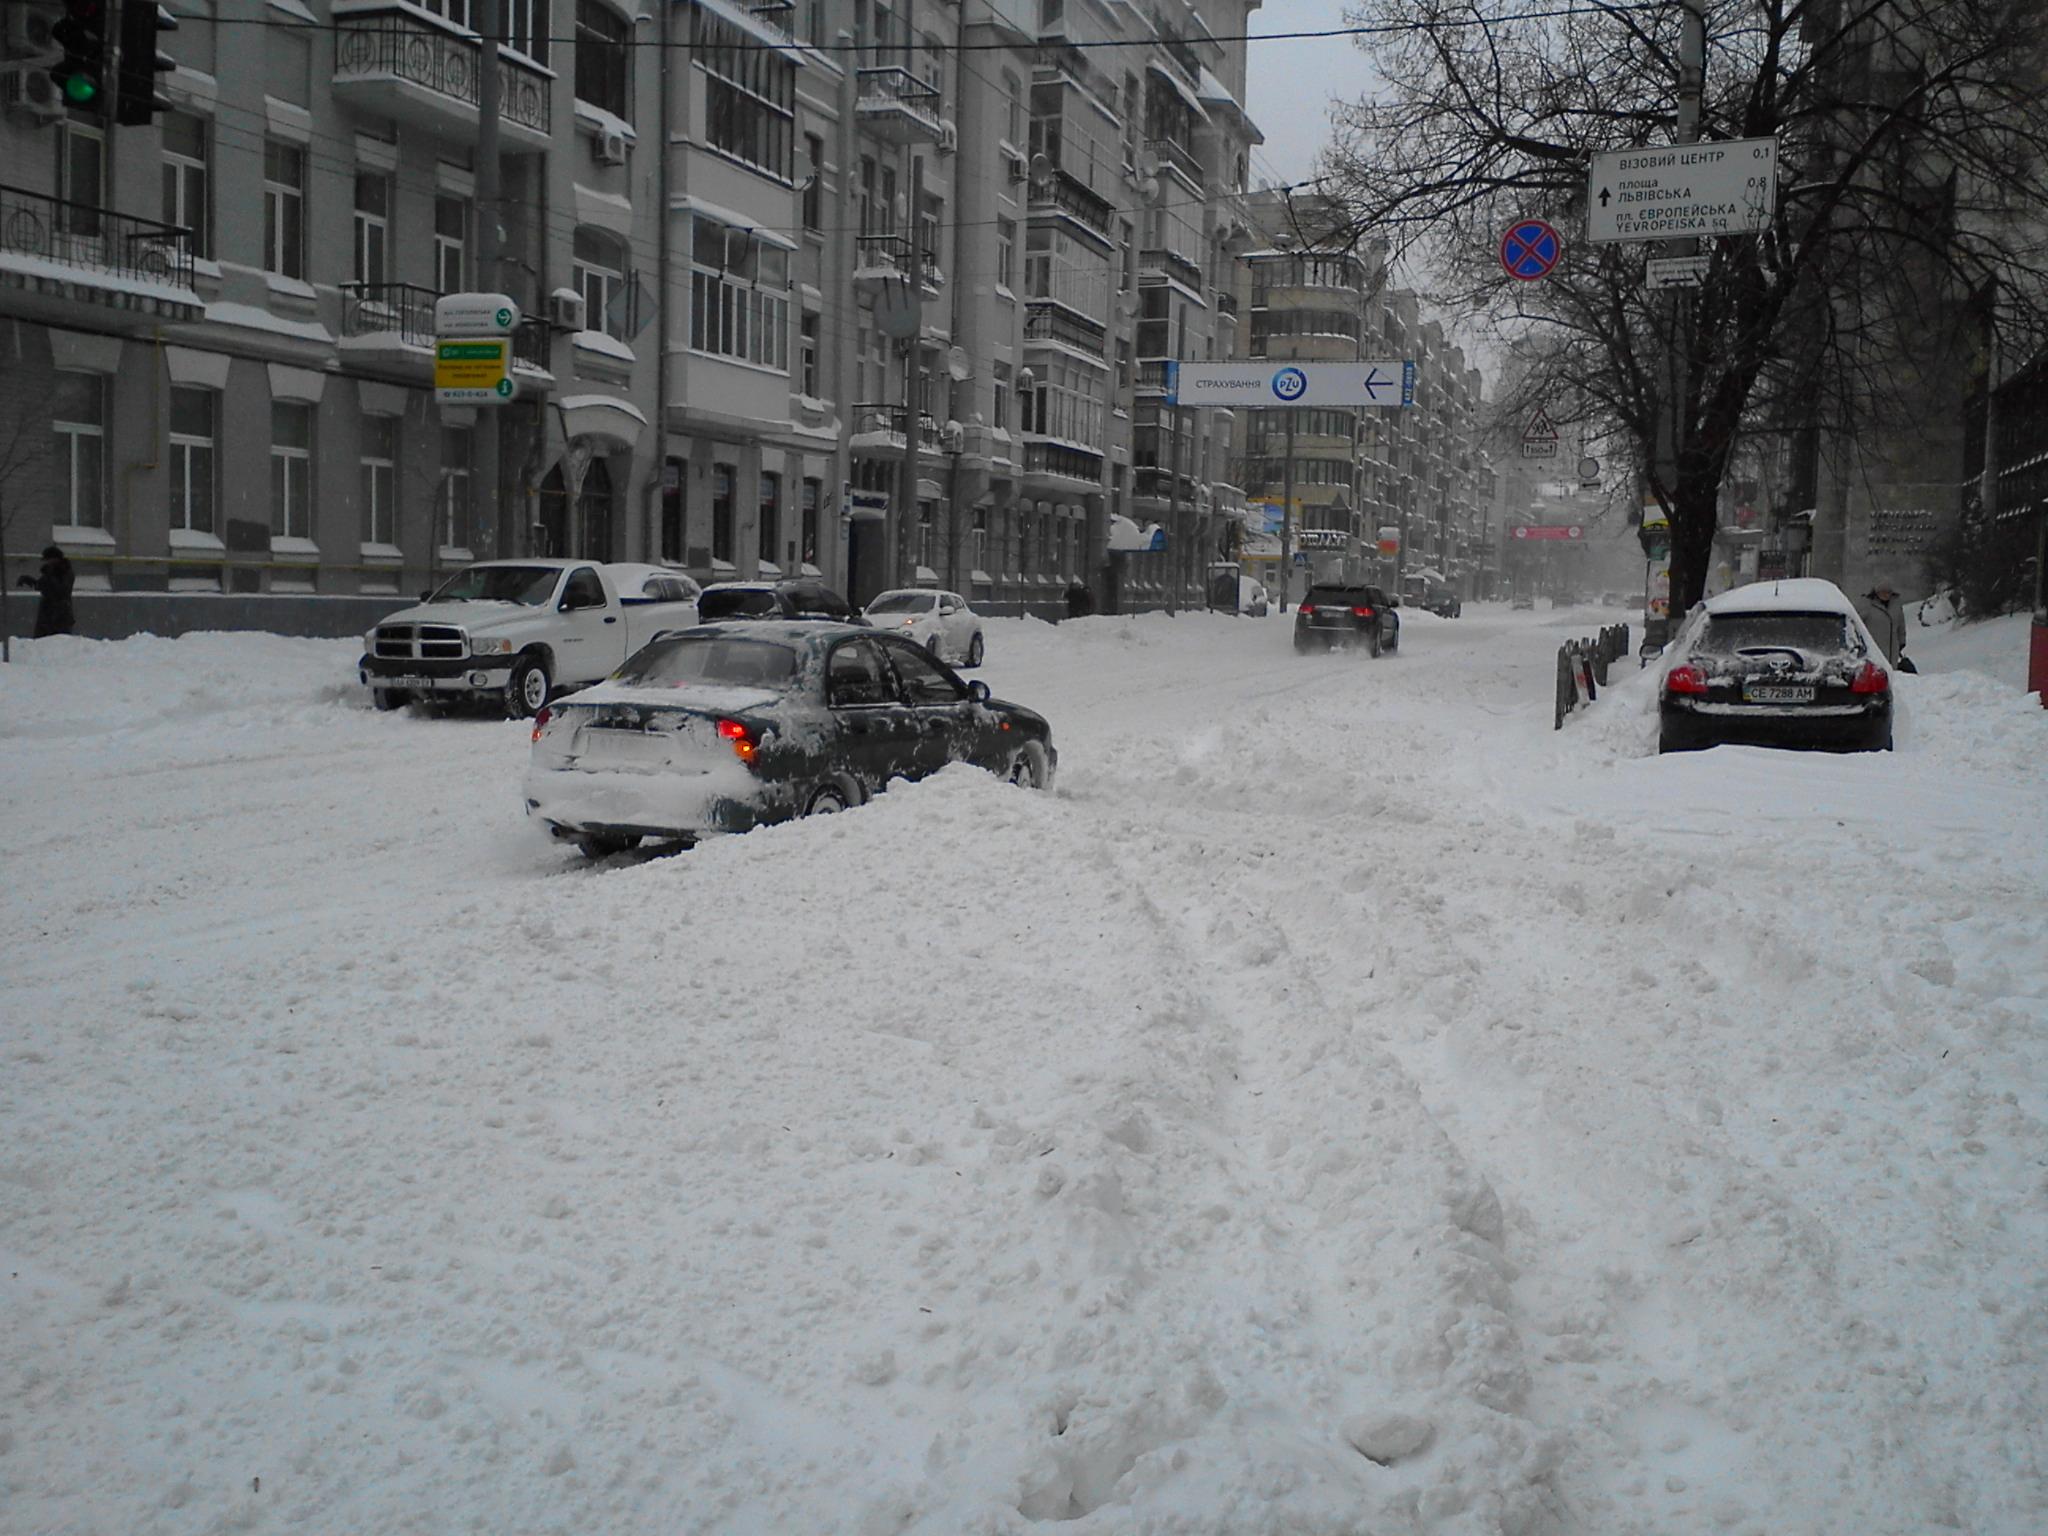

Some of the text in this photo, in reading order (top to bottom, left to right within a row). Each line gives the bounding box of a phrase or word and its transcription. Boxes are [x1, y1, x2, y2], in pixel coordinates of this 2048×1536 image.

[1619, 155, 1676, 170] ВІЗОВИЙ
[1681, 151, 1725, 166] ЦЕНТР
[1618, 178, 1659, 190] площа
[1617, 187, 1692, 203] ЛЬВІВСЬКА
[1616, 212, 1634, 222] пл.
[1639, 203, 1737, 220] ЄВРОПЕЙСЬКА
[1616, 217, 1707, 233] YEVROPEISKA
[1195, 379, 1261, 389] СТРАХУВАННЯ
[1279, 377, 1300, 392] PZU
[1752, 688, 1812, 698] CE 7288 AM
